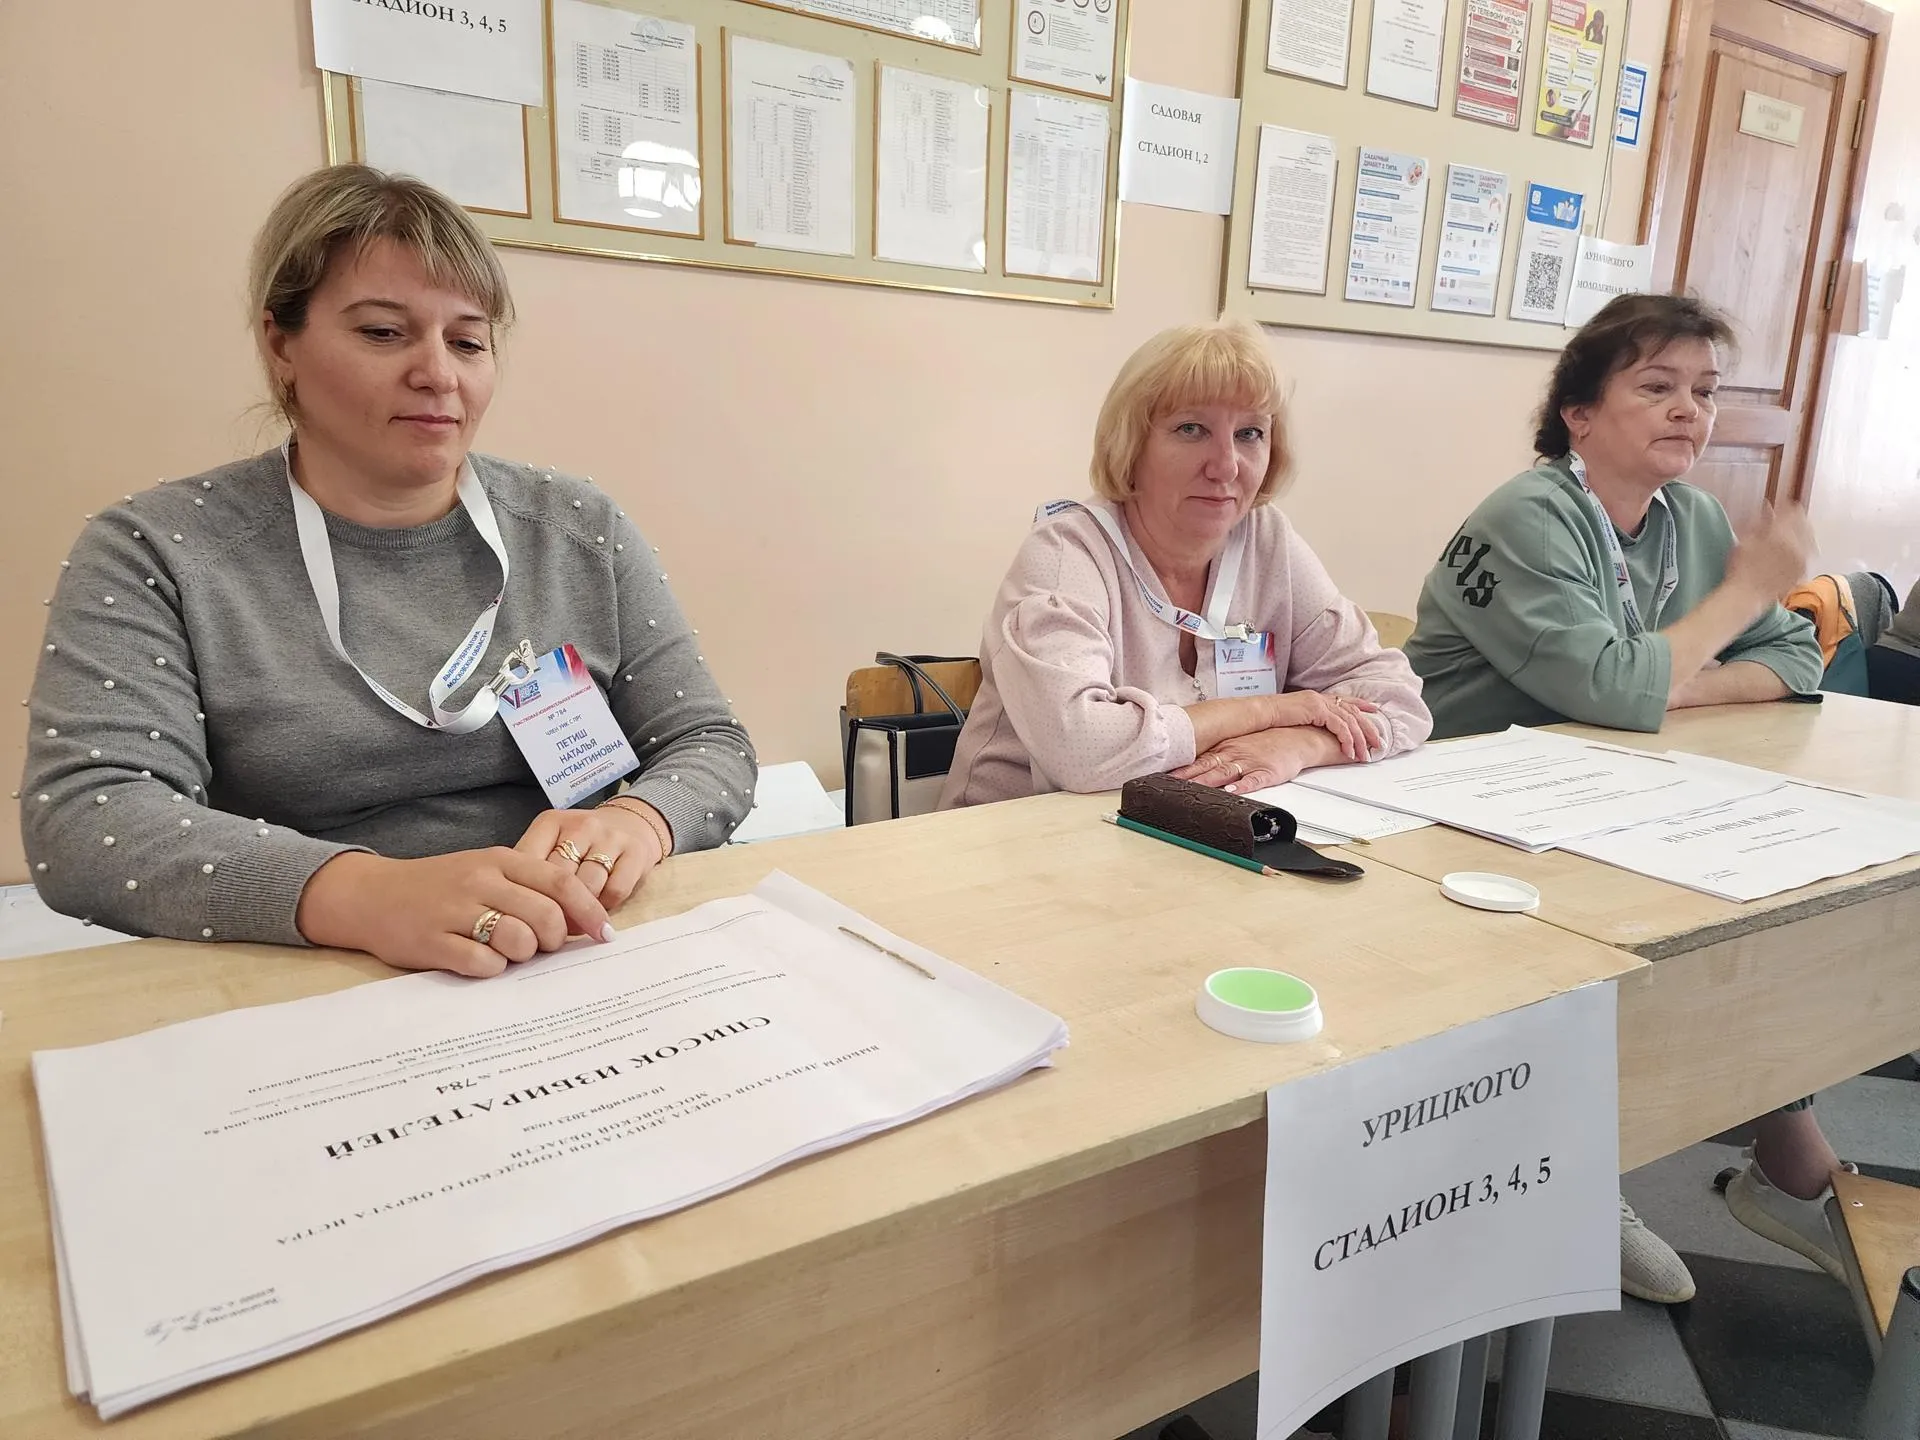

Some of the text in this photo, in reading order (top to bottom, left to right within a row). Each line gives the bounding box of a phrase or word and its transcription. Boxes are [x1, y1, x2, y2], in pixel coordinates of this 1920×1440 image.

[352, 0, 507, 34] АДИОН 3, 4, 5
[1464, 45, 1470, 58] 3
[1516, 40, 1522, 53] 2
[1511, 79, 1517, 90] 4
[1151, 103, 1202, 124] САДОВАЯ
[1138, 141, 1193, 160] СТАДИОН
[1203, 153, 1209, 163] 2
[1439, 516, 1501, 608] els
[555, 708, 567, 717] 784
[556, 728, 588, 750] ПЕТИШ
[559, 738, 598, 764] НАТАЛЬЯ
[545, 739, 624, 787] КОНСТАНТИНОВНА
[569, 761, 615, 788] МОСКОВСКАЯ ОБЛАСТЬ
[673, 967, 713, 981] выборах
[730, 972, 787, 988] Московская
[623, 979, 671, 997] депутатов
[585, 995, 621, 1009] Совета
[635, 998, 689, 1020] Городской
[531, 1006, 584, 1023] депутатов
[605, 1015, 633, 1029] округ
[468, 1022, 529, 1038] городского
[426, 1035, 466, 1049] округа
[540, 1037, 563, 1046] село
[546, 1032, 634, 1063] избирательному
[304, 1059, 383, 1080] Московской
[498, 1059, 544, 1075] участку
[248, 1077, 301, 1094] области
[324, 1016, 771, 1160] СПИСОК ИЗБИРАТЕЛЕЙ
[435, 1078, 478, 1095] 784
[522, 1086, 666, 1132] 10 сентября 2023 года
[1361, 1062, 1532, 1148] УРИЦКОГО
[224, 1120, 250, 1131] дом
[509, 1090, 709, 1159] МОСКОВСКОЙ ОБЛАСТИ
[276, 1044, 880, 1246] ВЫБОРЫ ДЕПУТАТОВ СОВЕТА ДЕПУТАТОВ ГОРОДСКОГО ОКРУГА ИСТРА
[1313, 1155, 1551, 1271] СТАДИОН 3, 4, 5
